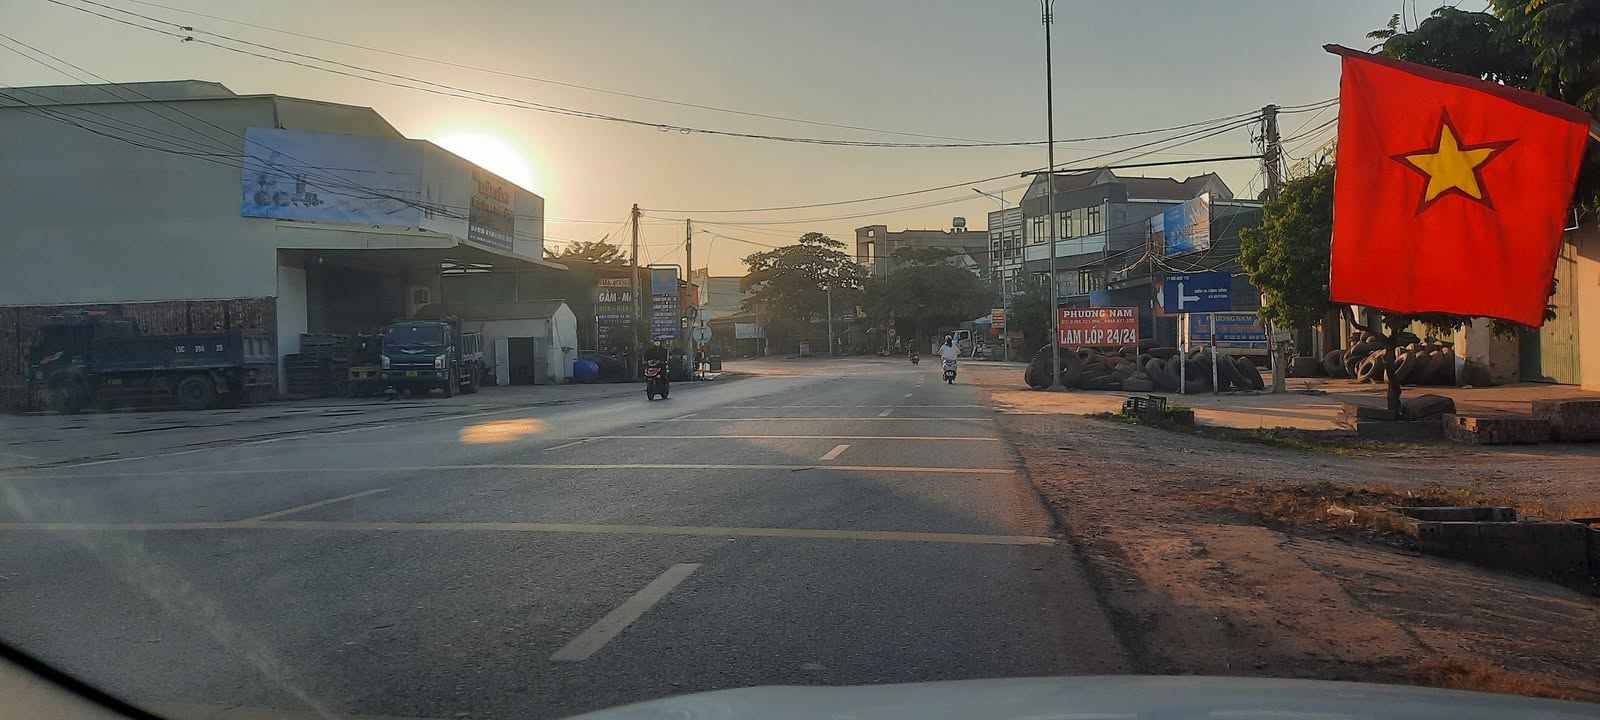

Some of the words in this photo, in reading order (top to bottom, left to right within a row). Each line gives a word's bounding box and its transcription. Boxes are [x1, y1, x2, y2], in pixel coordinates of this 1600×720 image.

[1109, 309, 1133, 317] NAM
[1060, 326, 1081, 344] LÀM
[1084, 324, 1104, 344] LỐP
[1106, 328, 1136, 345] 24/24
